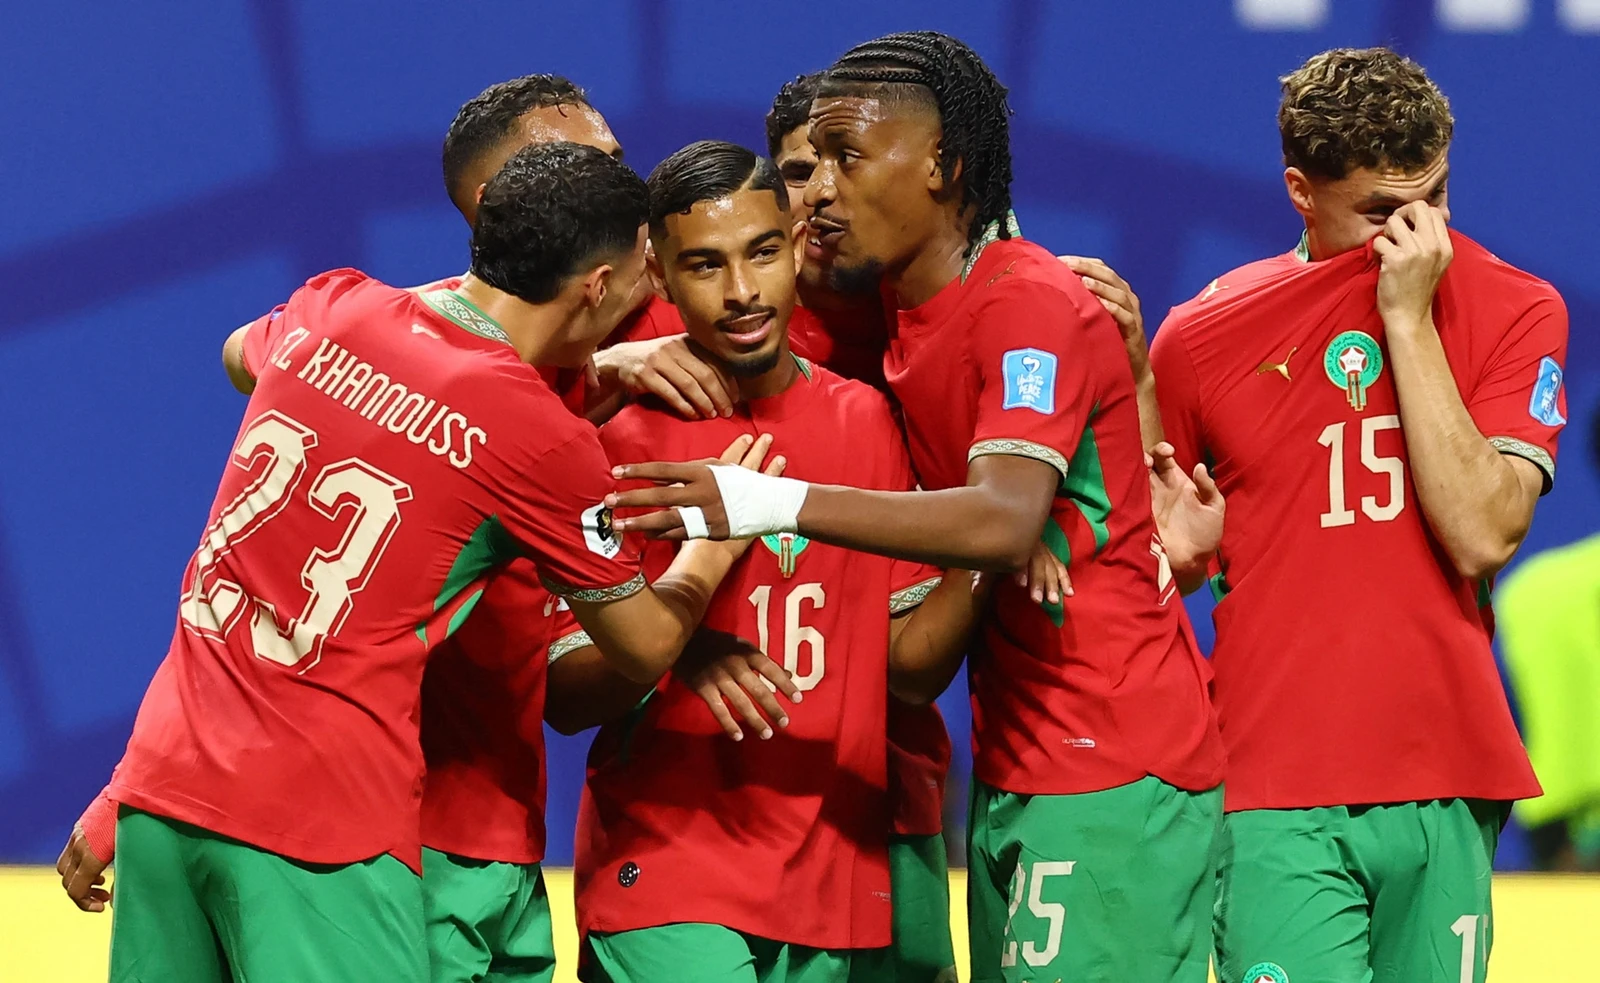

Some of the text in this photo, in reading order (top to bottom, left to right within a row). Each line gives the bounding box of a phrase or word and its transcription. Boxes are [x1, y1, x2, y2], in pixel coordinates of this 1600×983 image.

[269, 326, 488, 468] EL KHANNOUSS
[1317, 414, 1405, 528] 15
[180, 408, 414, 676] 23
[747, 582, 826, 693] 16
[1000, 860, 1078, 968] 25
[1450, 914, 1489, 983] 1
